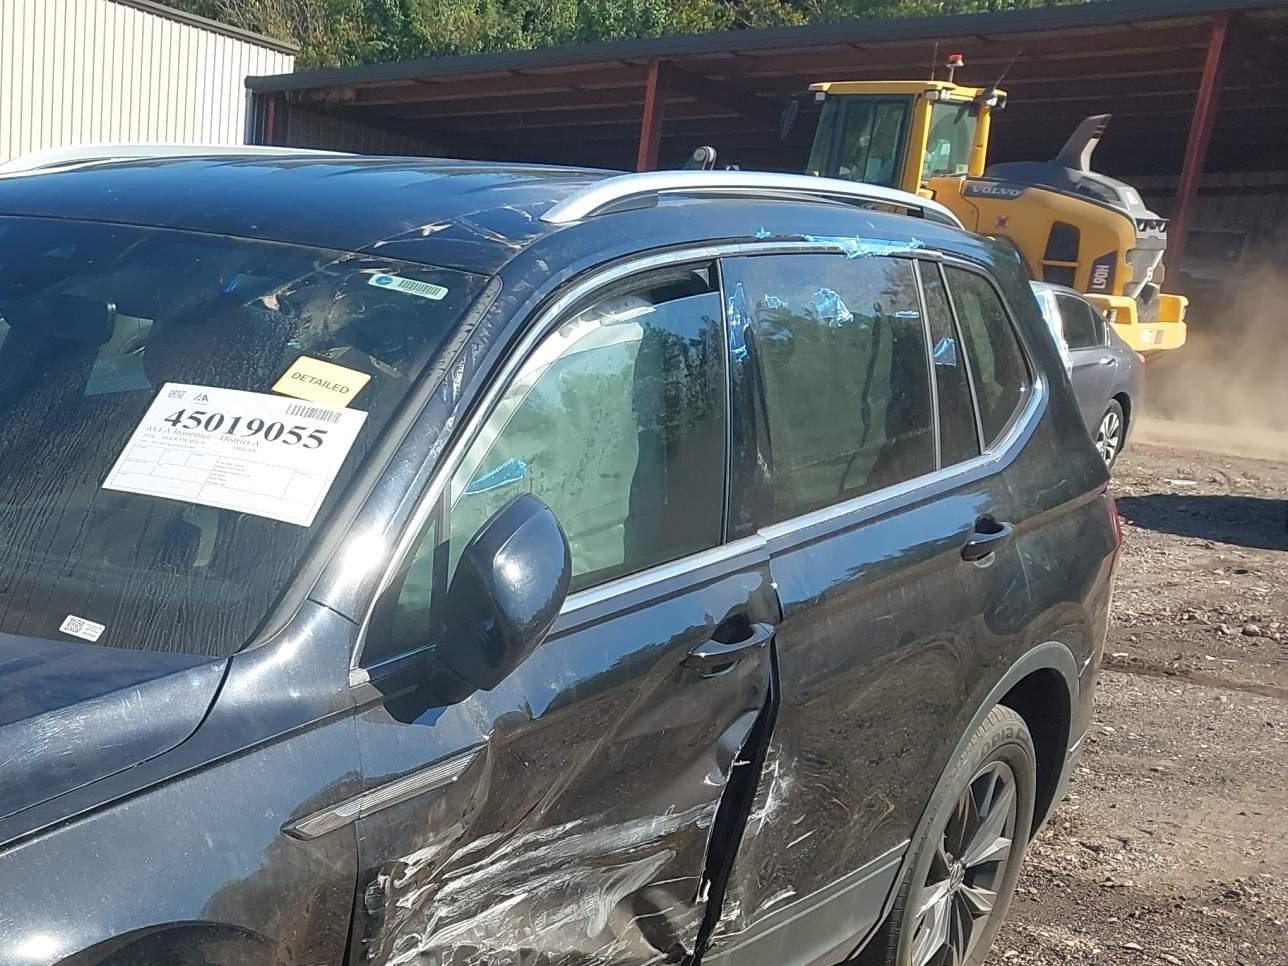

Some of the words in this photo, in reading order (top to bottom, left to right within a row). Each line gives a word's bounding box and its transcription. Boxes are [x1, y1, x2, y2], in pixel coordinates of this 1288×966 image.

[972, 185, 1021, 196] VOLVO
[1092, 264, 1110, 289] L90H
[291, 371, 350, 394] DETAILED
[164, 408, 328, 449] 45019055
